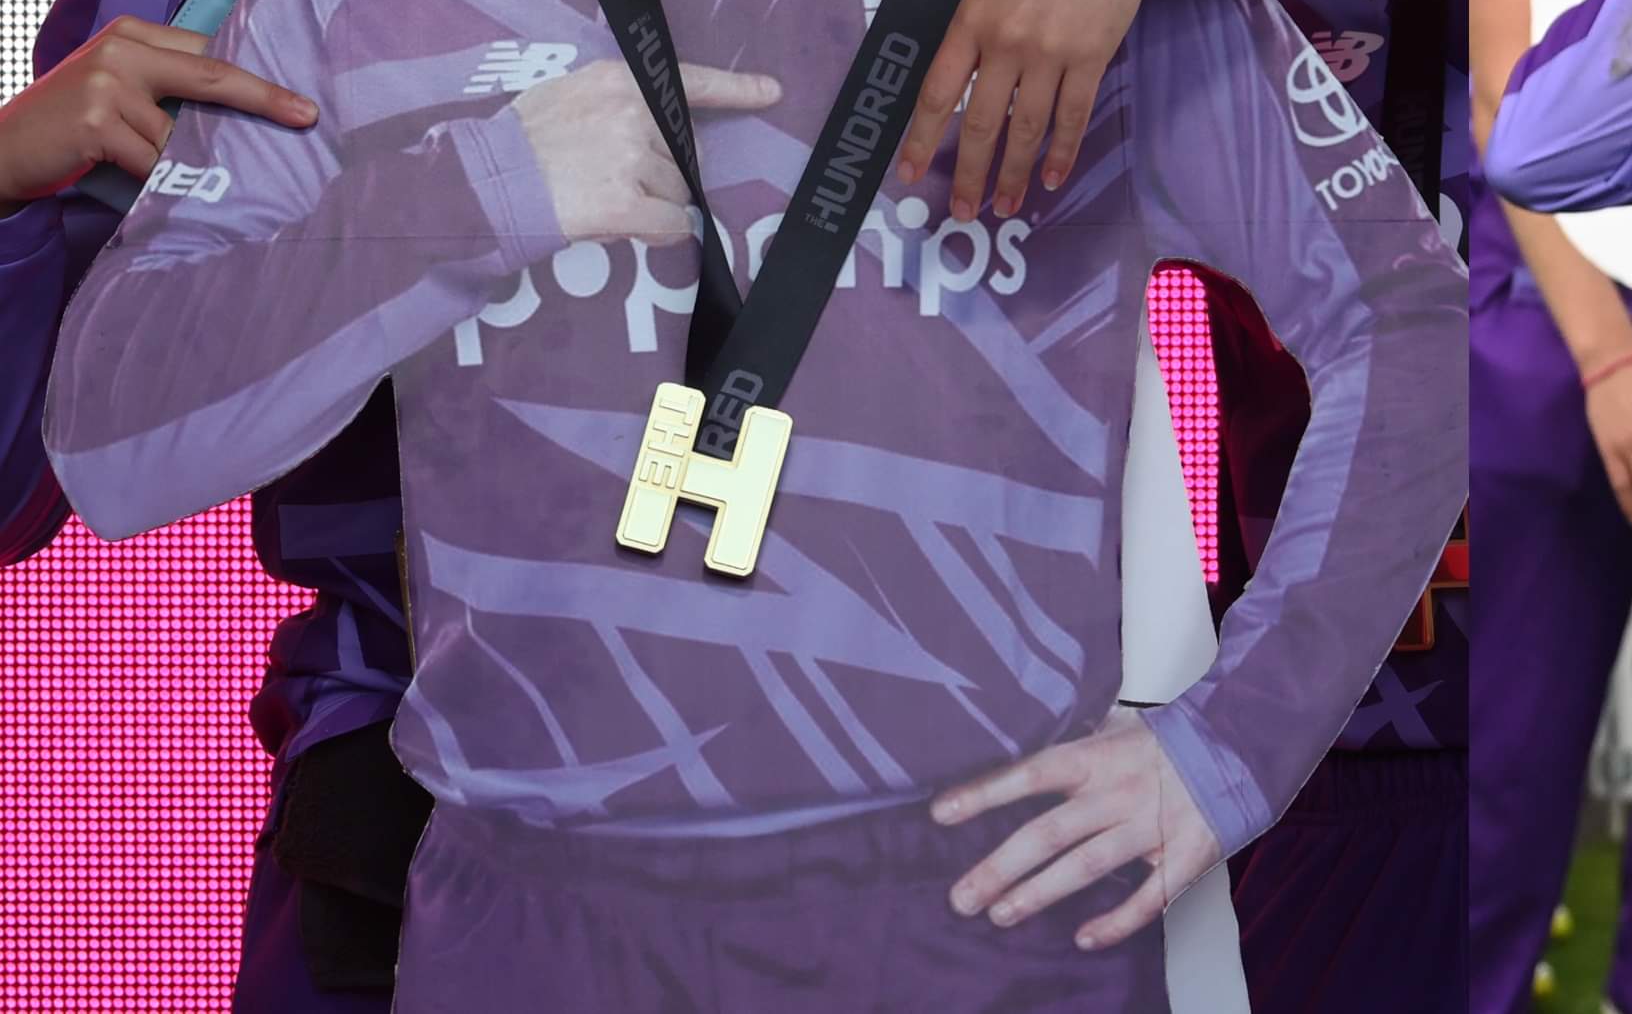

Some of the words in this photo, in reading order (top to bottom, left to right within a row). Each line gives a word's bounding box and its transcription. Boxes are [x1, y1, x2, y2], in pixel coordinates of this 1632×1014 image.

[628, 26, 701, 184] HUNDR
[811, 31, 921, 234] HUNDRED
[638, 394, 699, 489] THE
